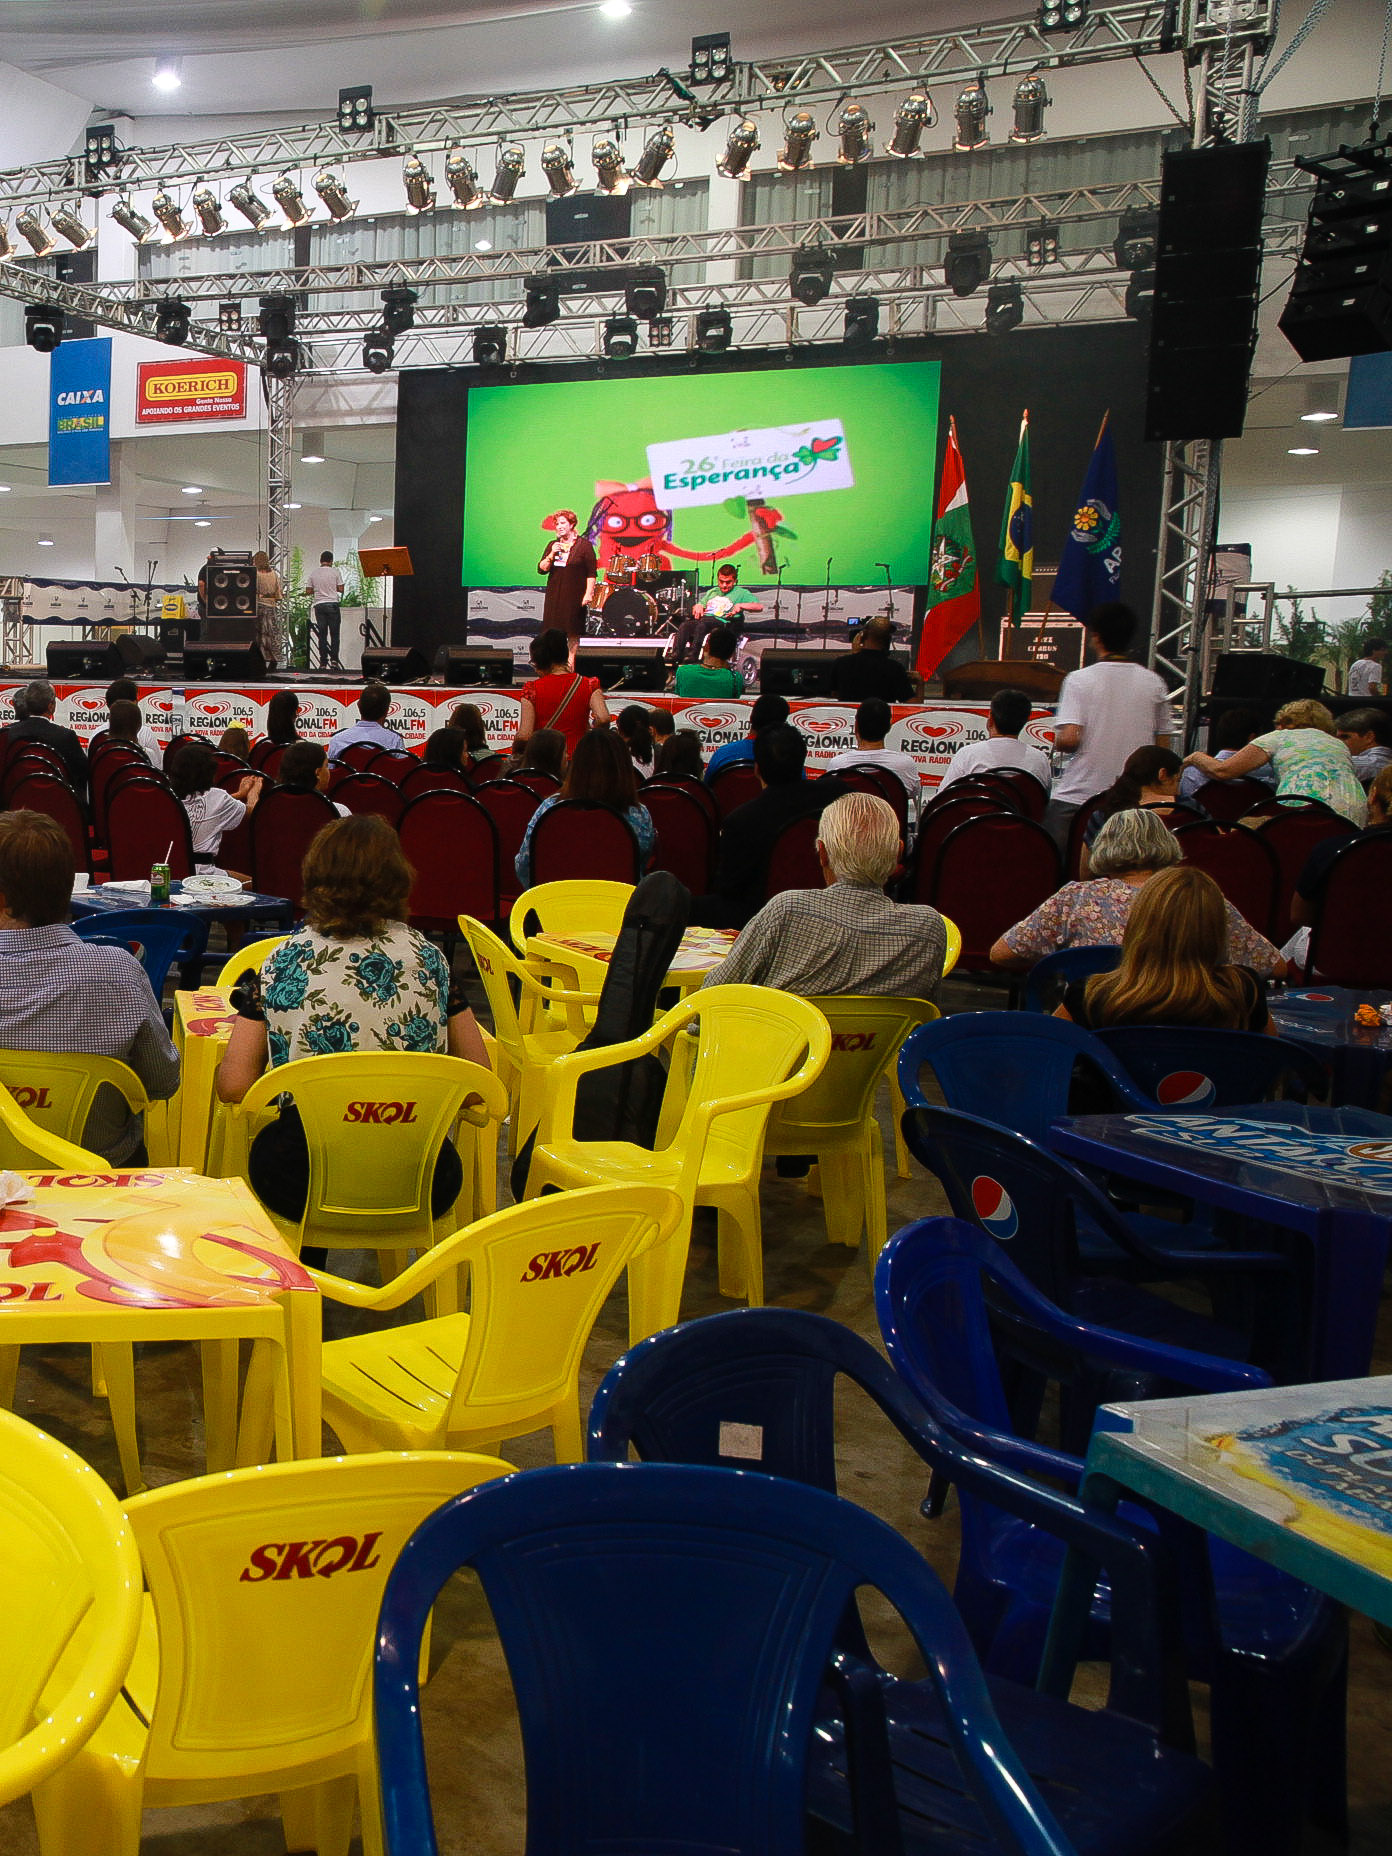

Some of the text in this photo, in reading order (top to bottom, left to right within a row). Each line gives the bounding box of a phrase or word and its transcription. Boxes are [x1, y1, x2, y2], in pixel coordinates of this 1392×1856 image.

[153, 378, 230, 395] KOERICH
[57, 389, 105, 406] CAIXA
[141, 403, 240, 416] APOIANDO OS GRANDES EVENTOS
[664, 460, 801, 491] Esperança
[232, 706, 254, 717] 106,5
[315, 707, 338, 718] 106,5
[403, 708, 426, 719] 106,5
[494, 708, 519, 719] 106,5
[405, 732, 426, 740] CIDADE
[928, 755, 952, 765] RÁDIO
[343, 1101, 418, 1125] SKOL
[26, 1173, 166, 1188] SKOL
[519, 1240, 602, 1283] SKOL
[239, 1531, 384, 1583] SKOL
